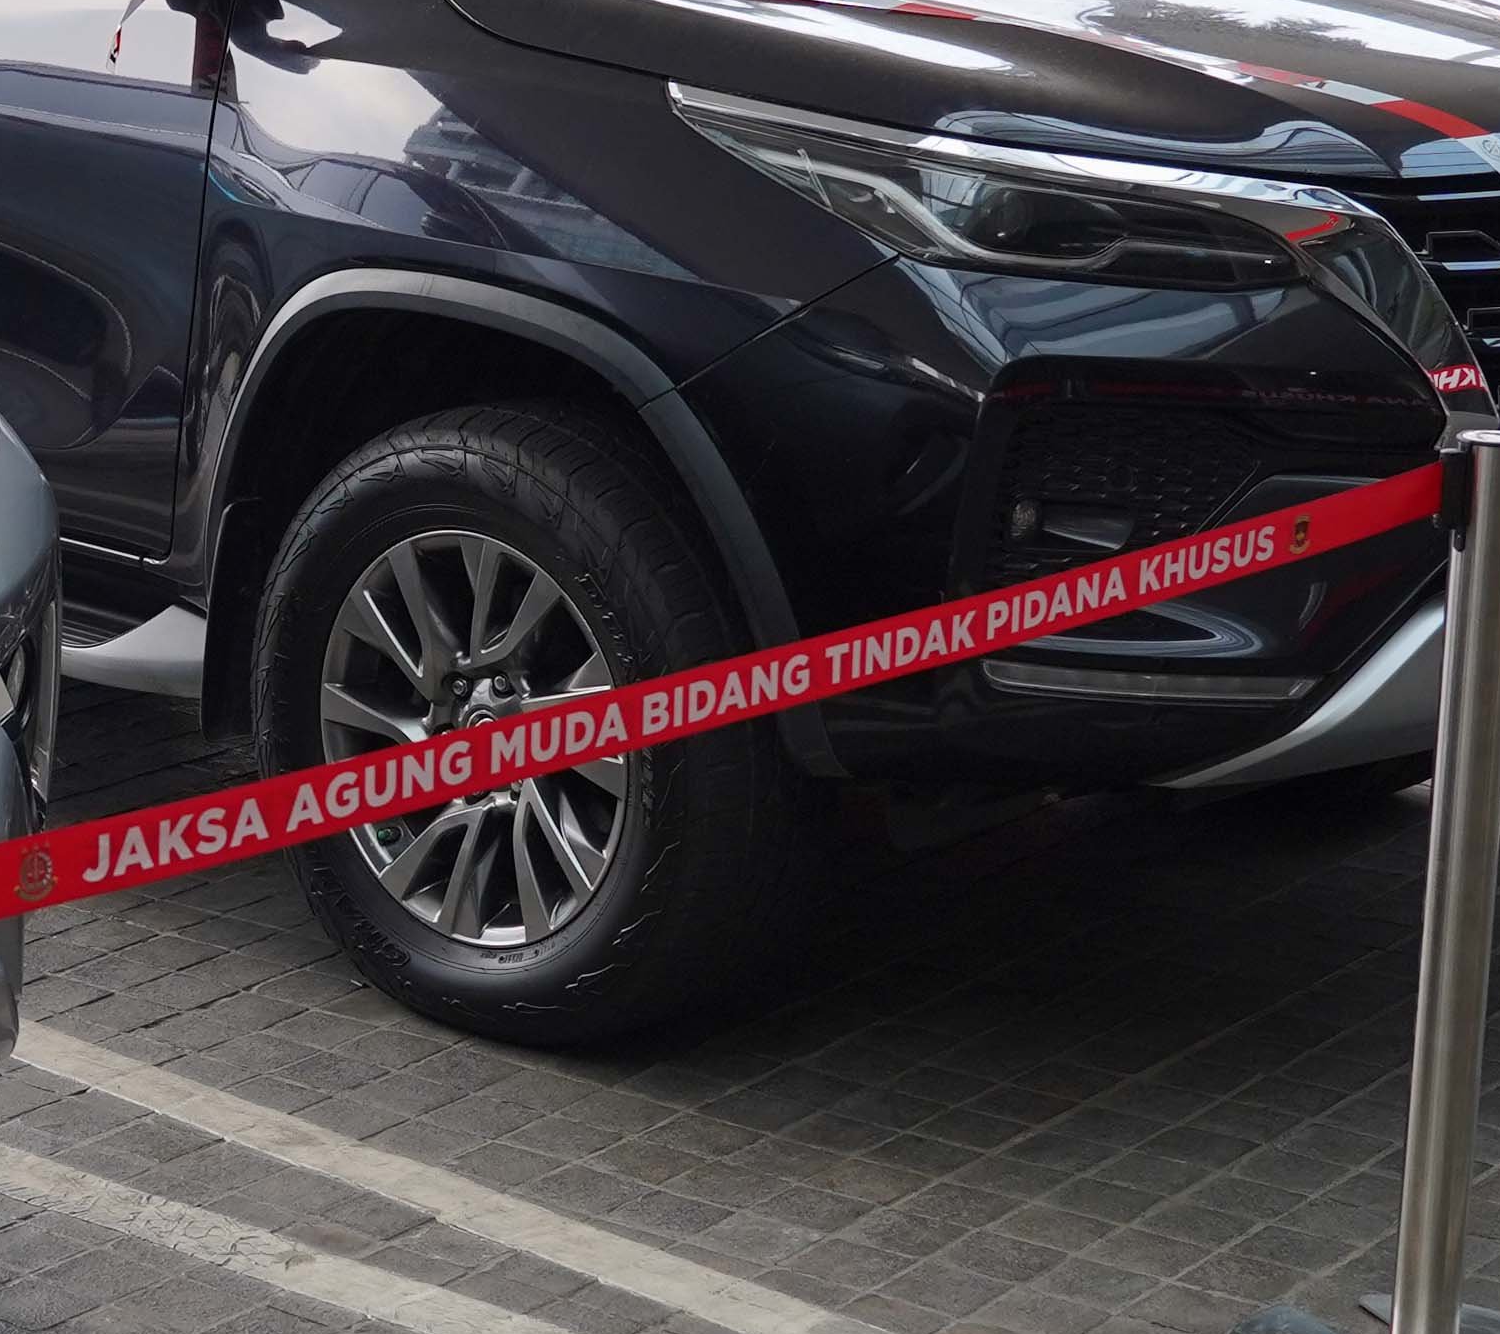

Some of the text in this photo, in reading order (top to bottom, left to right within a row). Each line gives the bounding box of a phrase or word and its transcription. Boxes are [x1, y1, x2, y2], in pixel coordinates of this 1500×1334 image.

[82, 524, 1276, 884] JAKSA AGUNG MUDA BIDANG TINDAK PIDANA KHUSUS
